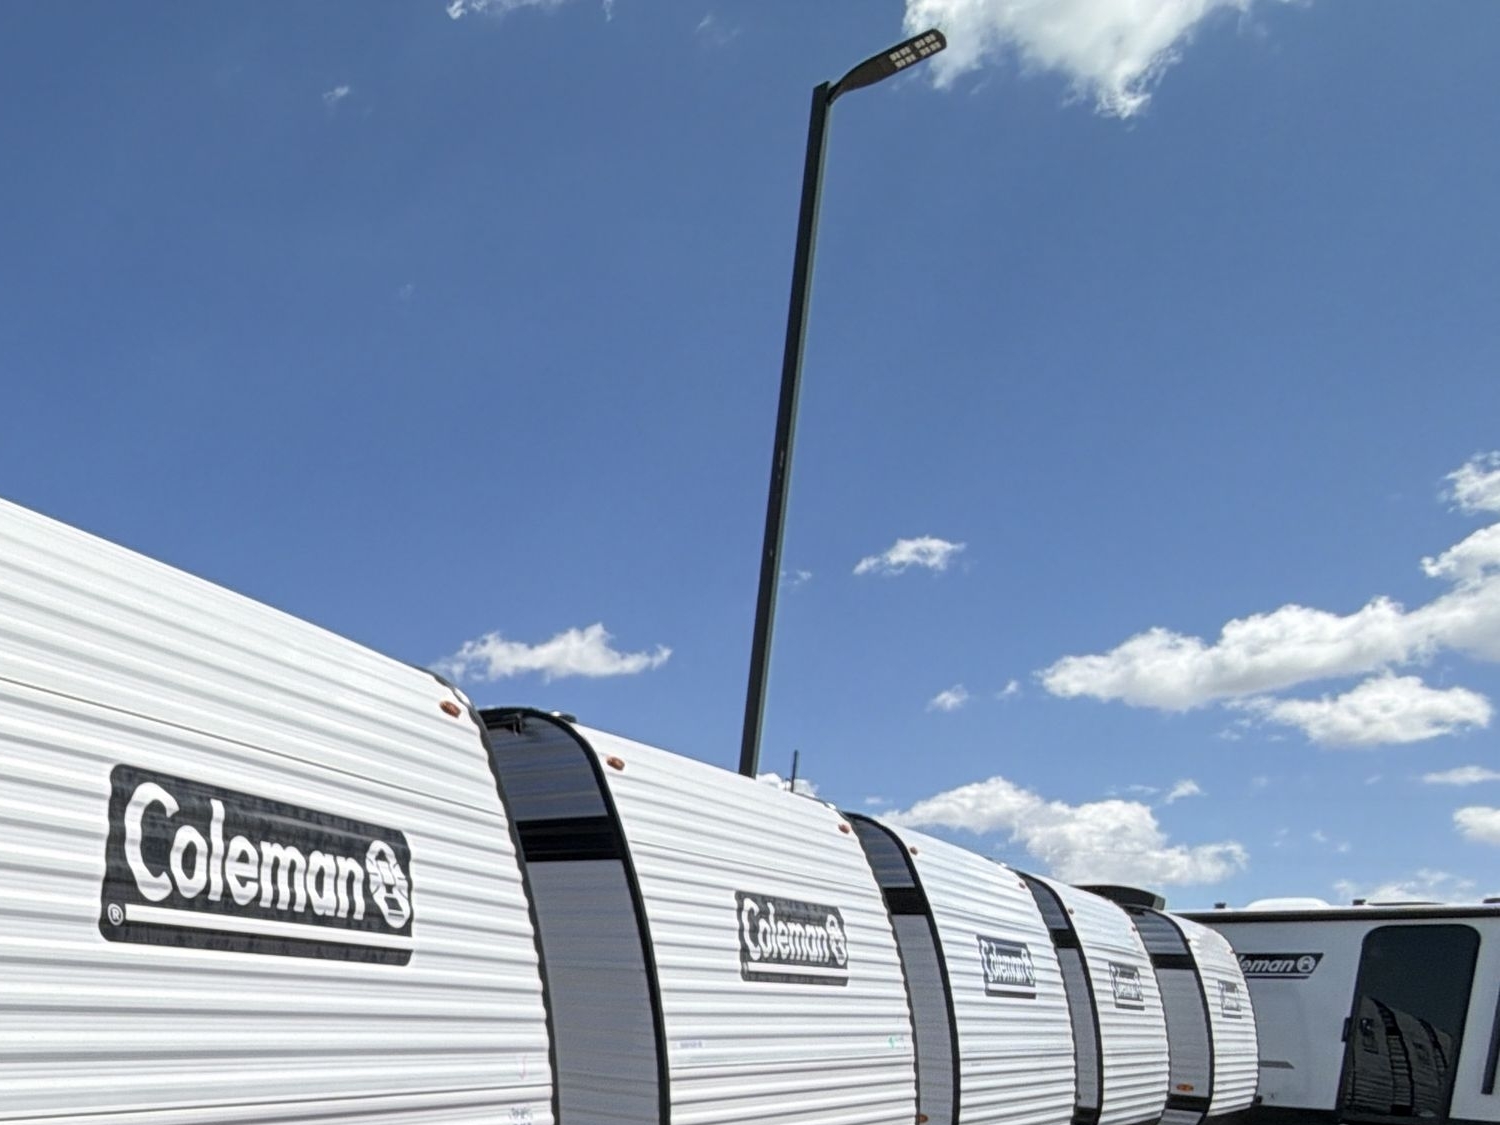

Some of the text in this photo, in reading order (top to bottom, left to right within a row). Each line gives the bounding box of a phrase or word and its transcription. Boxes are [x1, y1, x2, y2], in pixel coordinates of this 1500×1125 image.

[124, 781, 366, 920] Coleman
[741, 897, 830, 961] Coleman
[1238, 955, 1296, 972] eman
